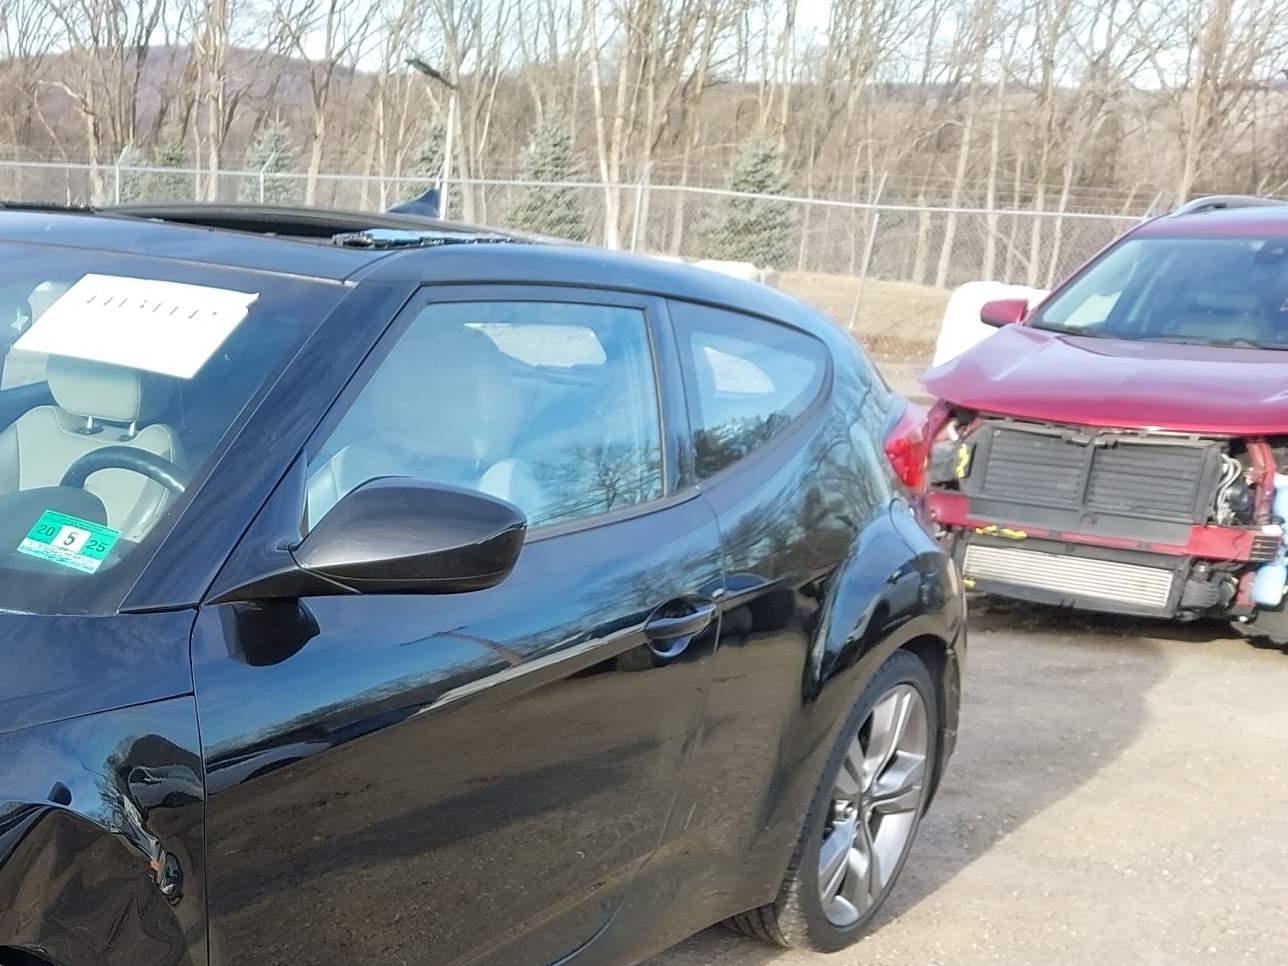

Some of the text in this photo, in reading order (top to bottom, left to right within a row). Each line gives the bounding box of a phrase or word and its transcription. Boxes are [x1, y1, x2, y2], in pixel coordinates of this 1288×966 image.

[37, 525, 108, 553] 20 5 25
